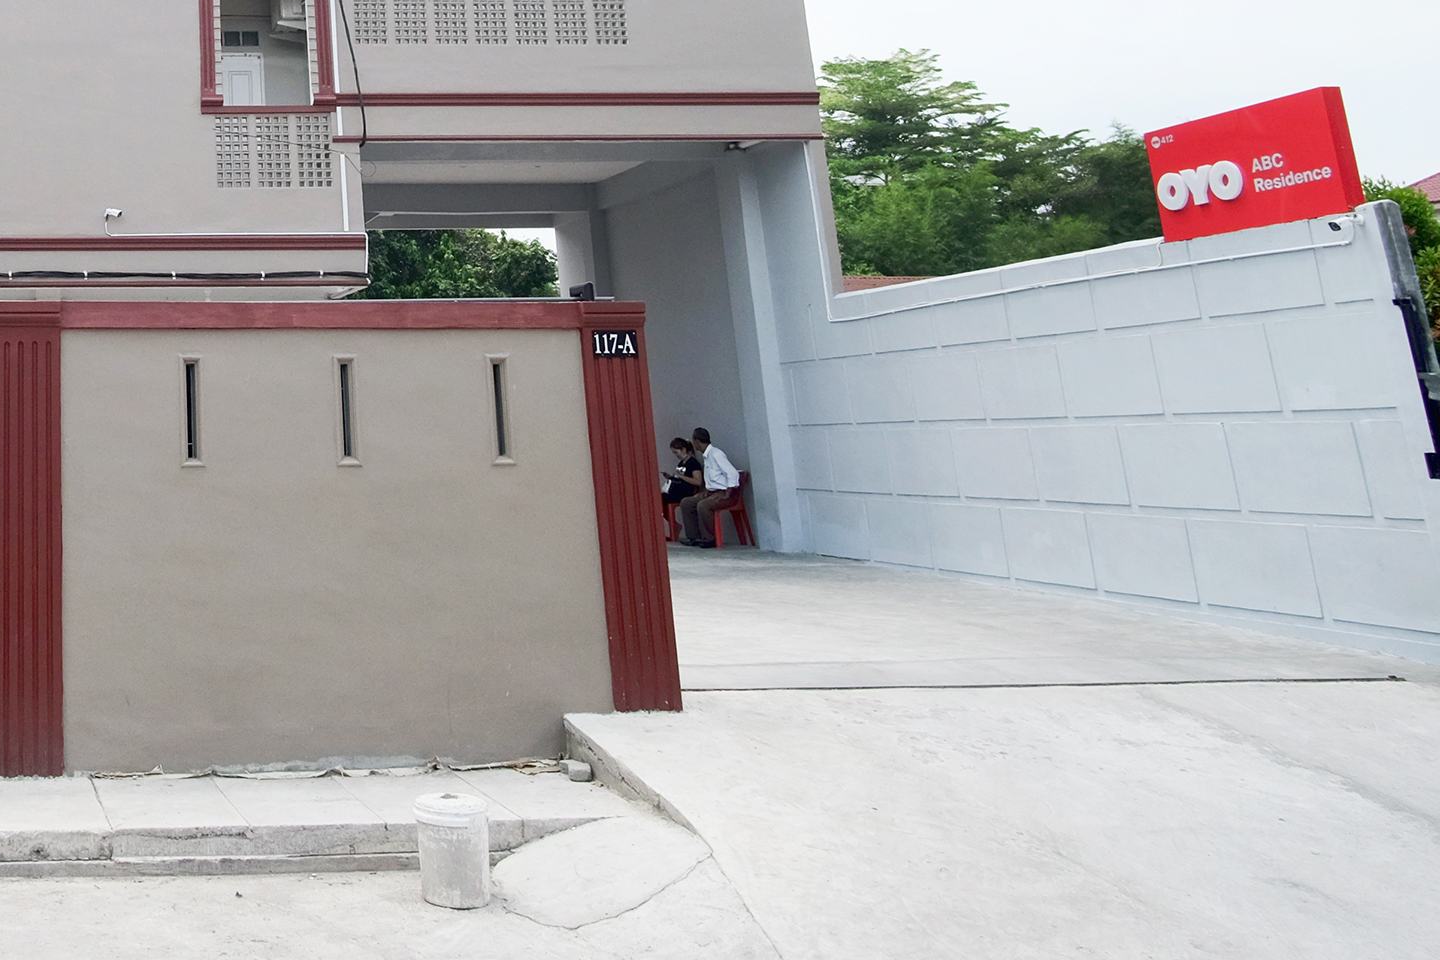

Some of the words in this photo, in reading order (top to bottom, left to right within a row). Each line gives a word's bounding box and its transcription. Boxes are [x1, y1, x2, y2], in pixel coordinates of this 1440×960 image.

[1251, 153, 1284, 173] ABC
[1157, 160, 1244, 211] OYO
[1253, 166, 1332, 192] Residence
[594, 333, 636, 354] 117-A
